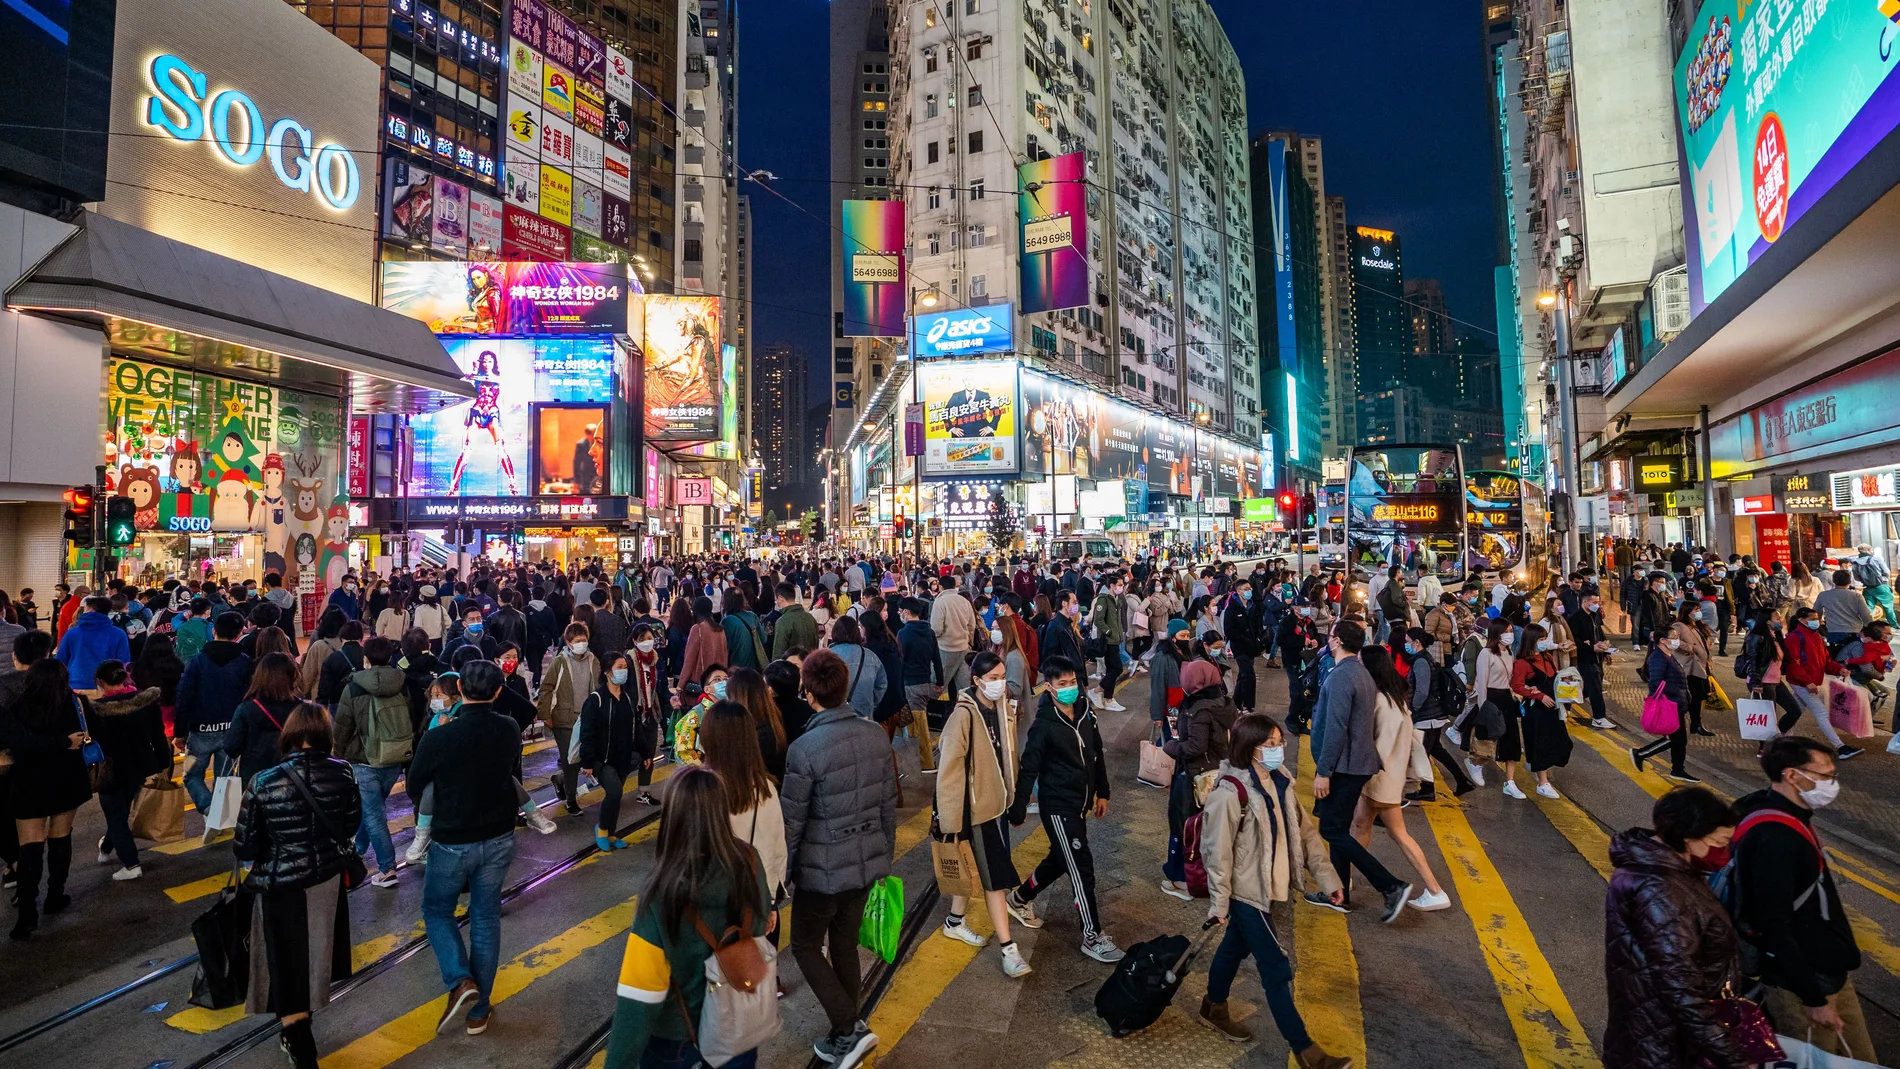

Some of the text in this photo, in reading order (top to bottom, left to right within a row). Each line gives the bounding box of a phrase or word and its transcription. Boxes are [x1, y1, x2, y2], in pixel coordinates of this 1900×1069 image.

[547, 7, 565, 37] THAI
[564, 23, 576, 41] Food
[531, 52, 542, 65] 7/F
[147, 54, 361, 210] SOGO
[528, 190, 538, 200] 5/F
[1026, 231, 1071, 248] 5649 6988
[1361, 256, 1394, 270] Rosedale
[854, 267, 898, 278] 5649 6988
[510, 283, 620, 301] 神奇女俠1984
[946, 317, 993, 338] asics
[1774, 395, 1837, 440] BEA 東亞銀行
[684, 482, 703, 499] iB
[1785, 495, 1827, 506] 北京同仁堂
[1418, 505, 1438, 519] 116
[1490, 513, 1506, 524] 112
[169, 515, 212, 532] SOGO
[940, 858, 959, 866] LUSH
